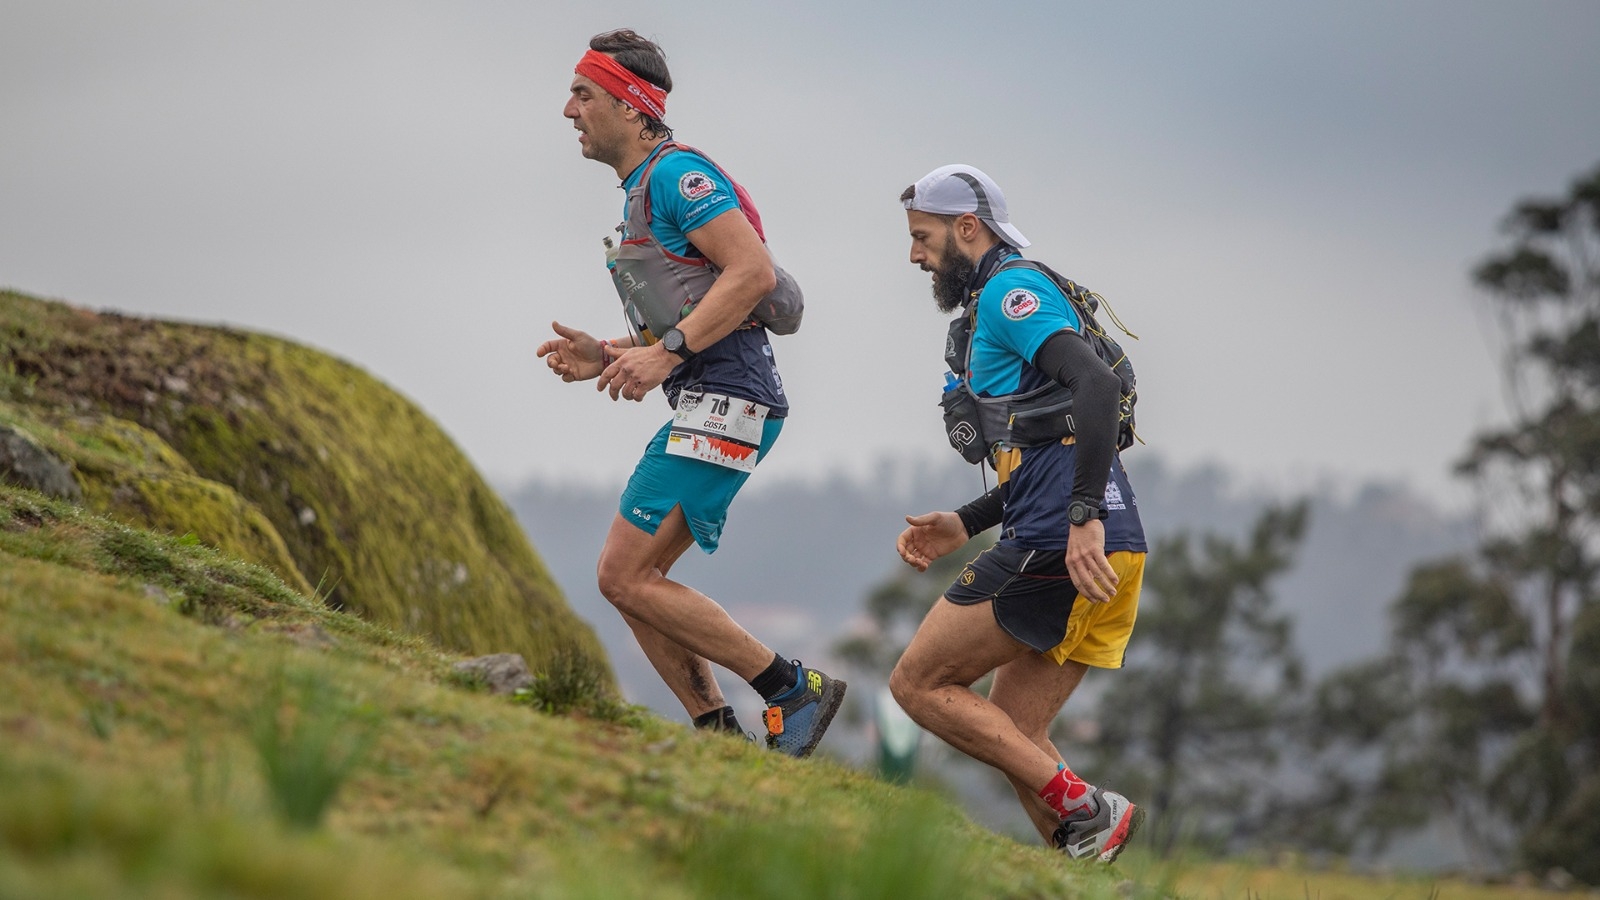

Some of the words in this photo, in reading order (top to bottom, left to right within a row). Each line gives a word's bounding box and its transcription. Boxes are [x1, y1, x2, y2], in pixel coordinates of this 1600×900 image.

[1013, 299, 1033, 314] GOBS
[708, 415, 725, 423] PEDRO
[703, 420, 727, 431] COSTA
